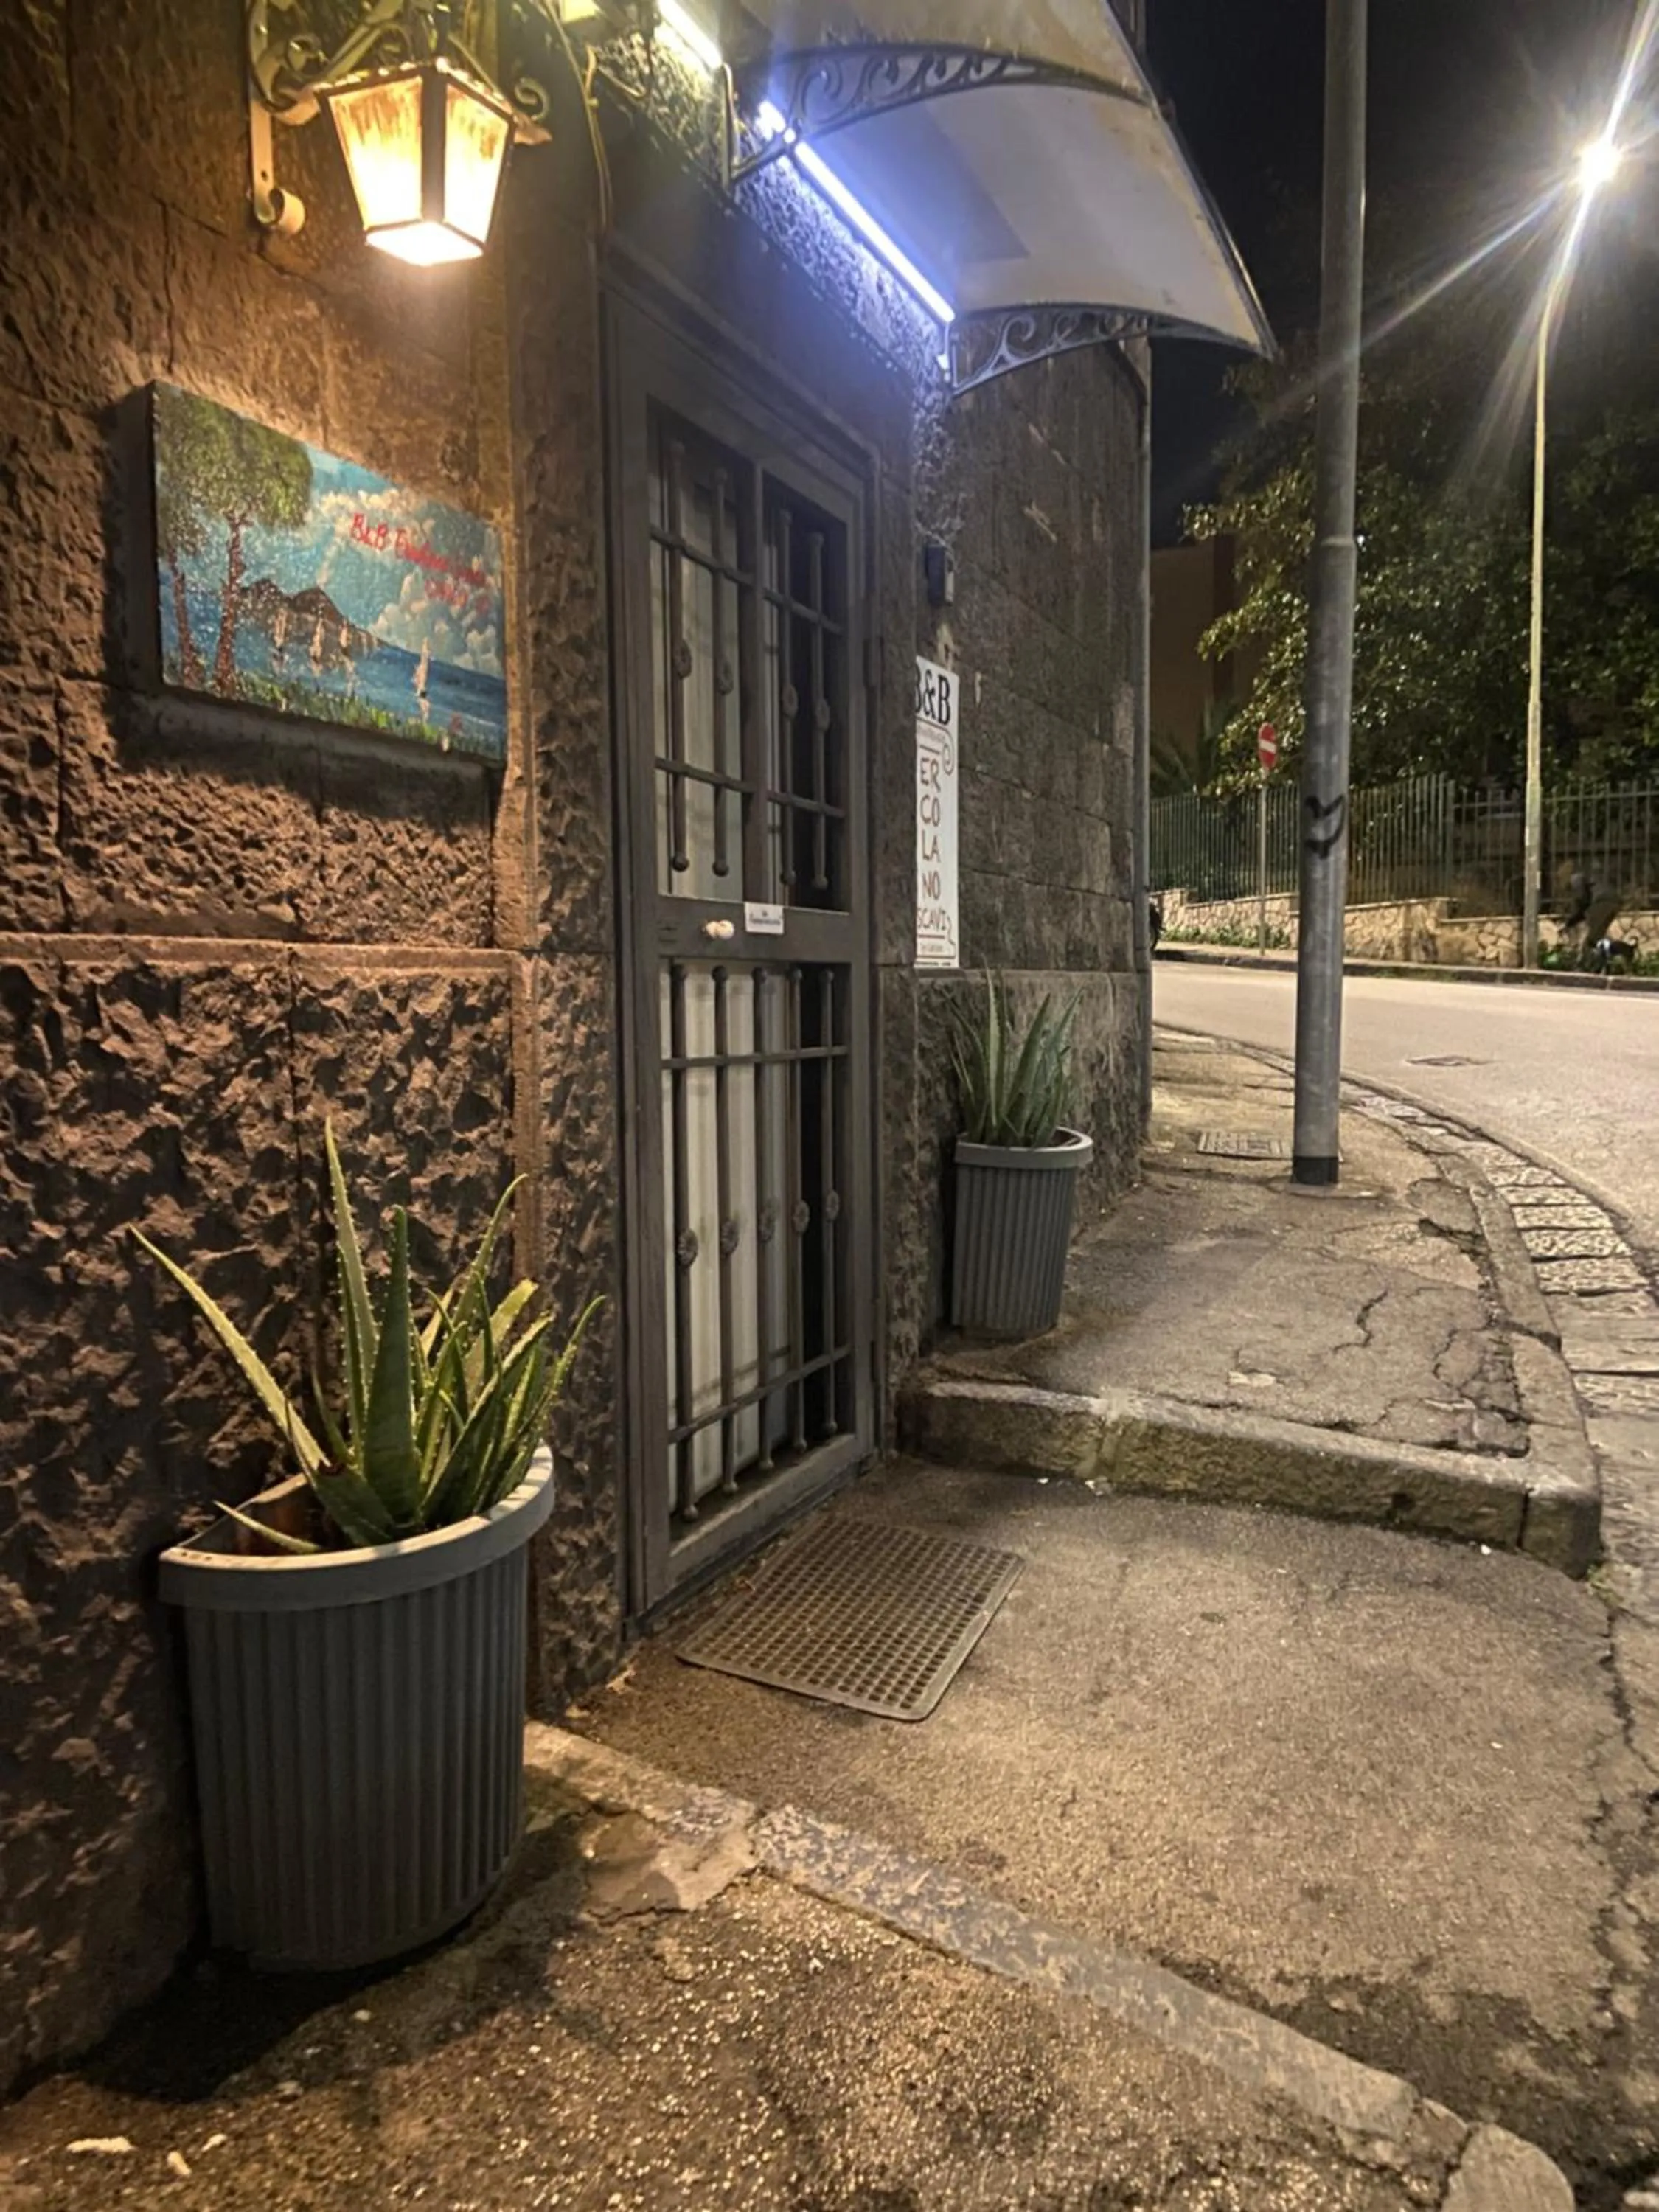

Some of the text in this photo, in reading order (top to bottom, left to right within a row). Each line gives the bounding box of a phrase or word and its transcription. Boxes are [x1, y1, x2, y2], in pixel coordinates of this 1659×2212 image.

[920, 758, 941, 793] ER
[920, 794, 941, 827] CO
[921, 830, 940, 863] LA
[922, 870, 941, 901] NO
[917, 907, 947, 932] SCAVI
